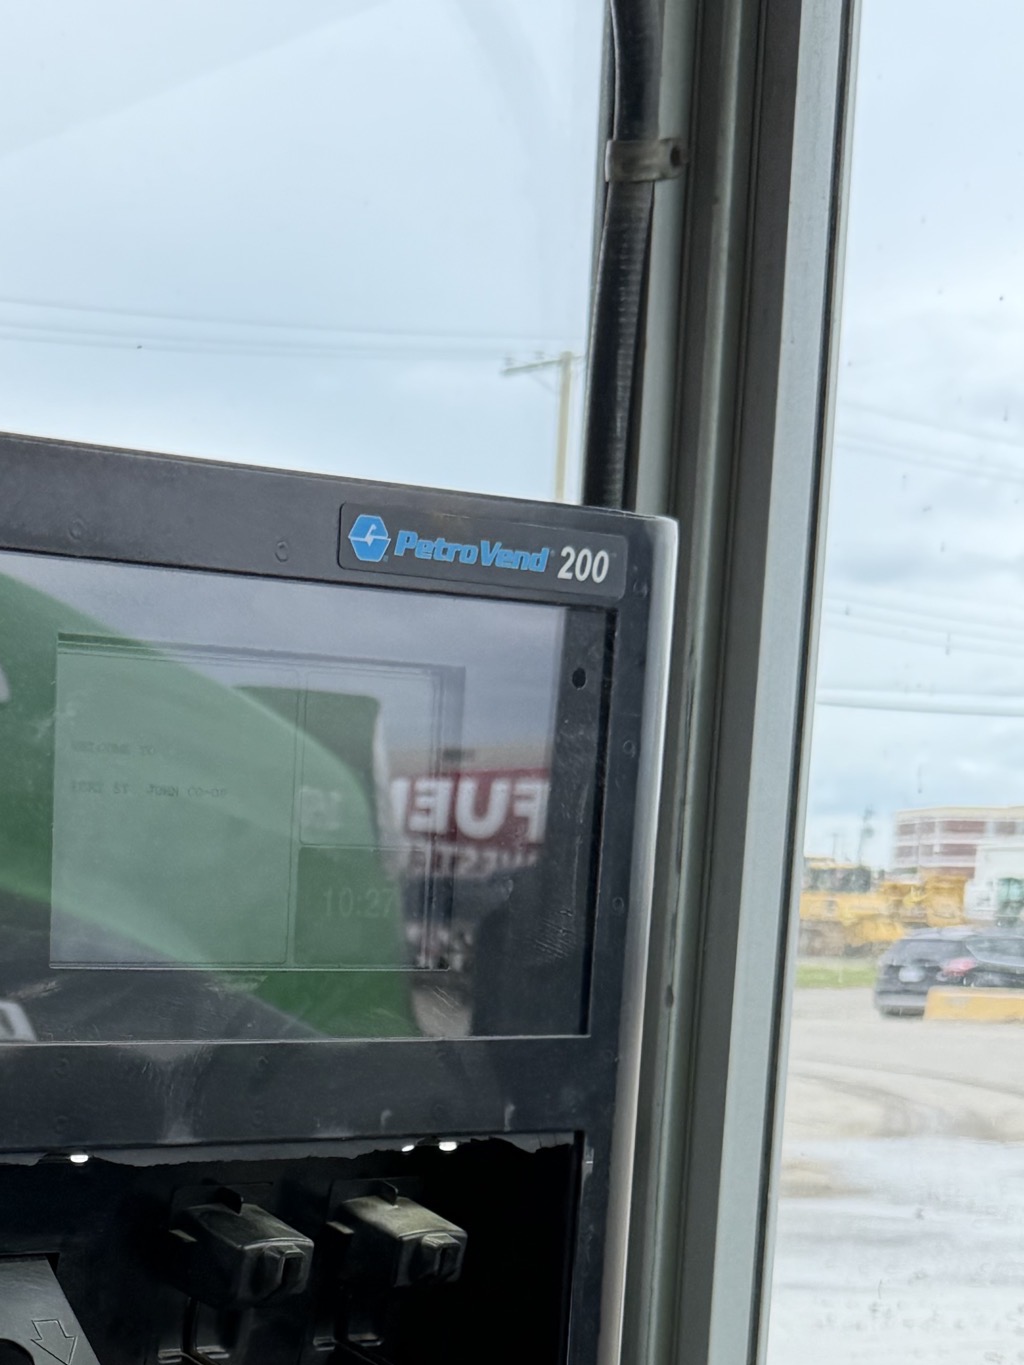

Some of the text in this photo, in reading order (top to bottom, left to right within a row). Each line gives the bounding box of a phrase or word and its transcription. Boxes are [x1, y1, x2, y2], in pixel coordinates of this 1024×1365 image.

[393, 530, 610, 583] PetroVend 200
[323, 887, 394, 918] 10:27
